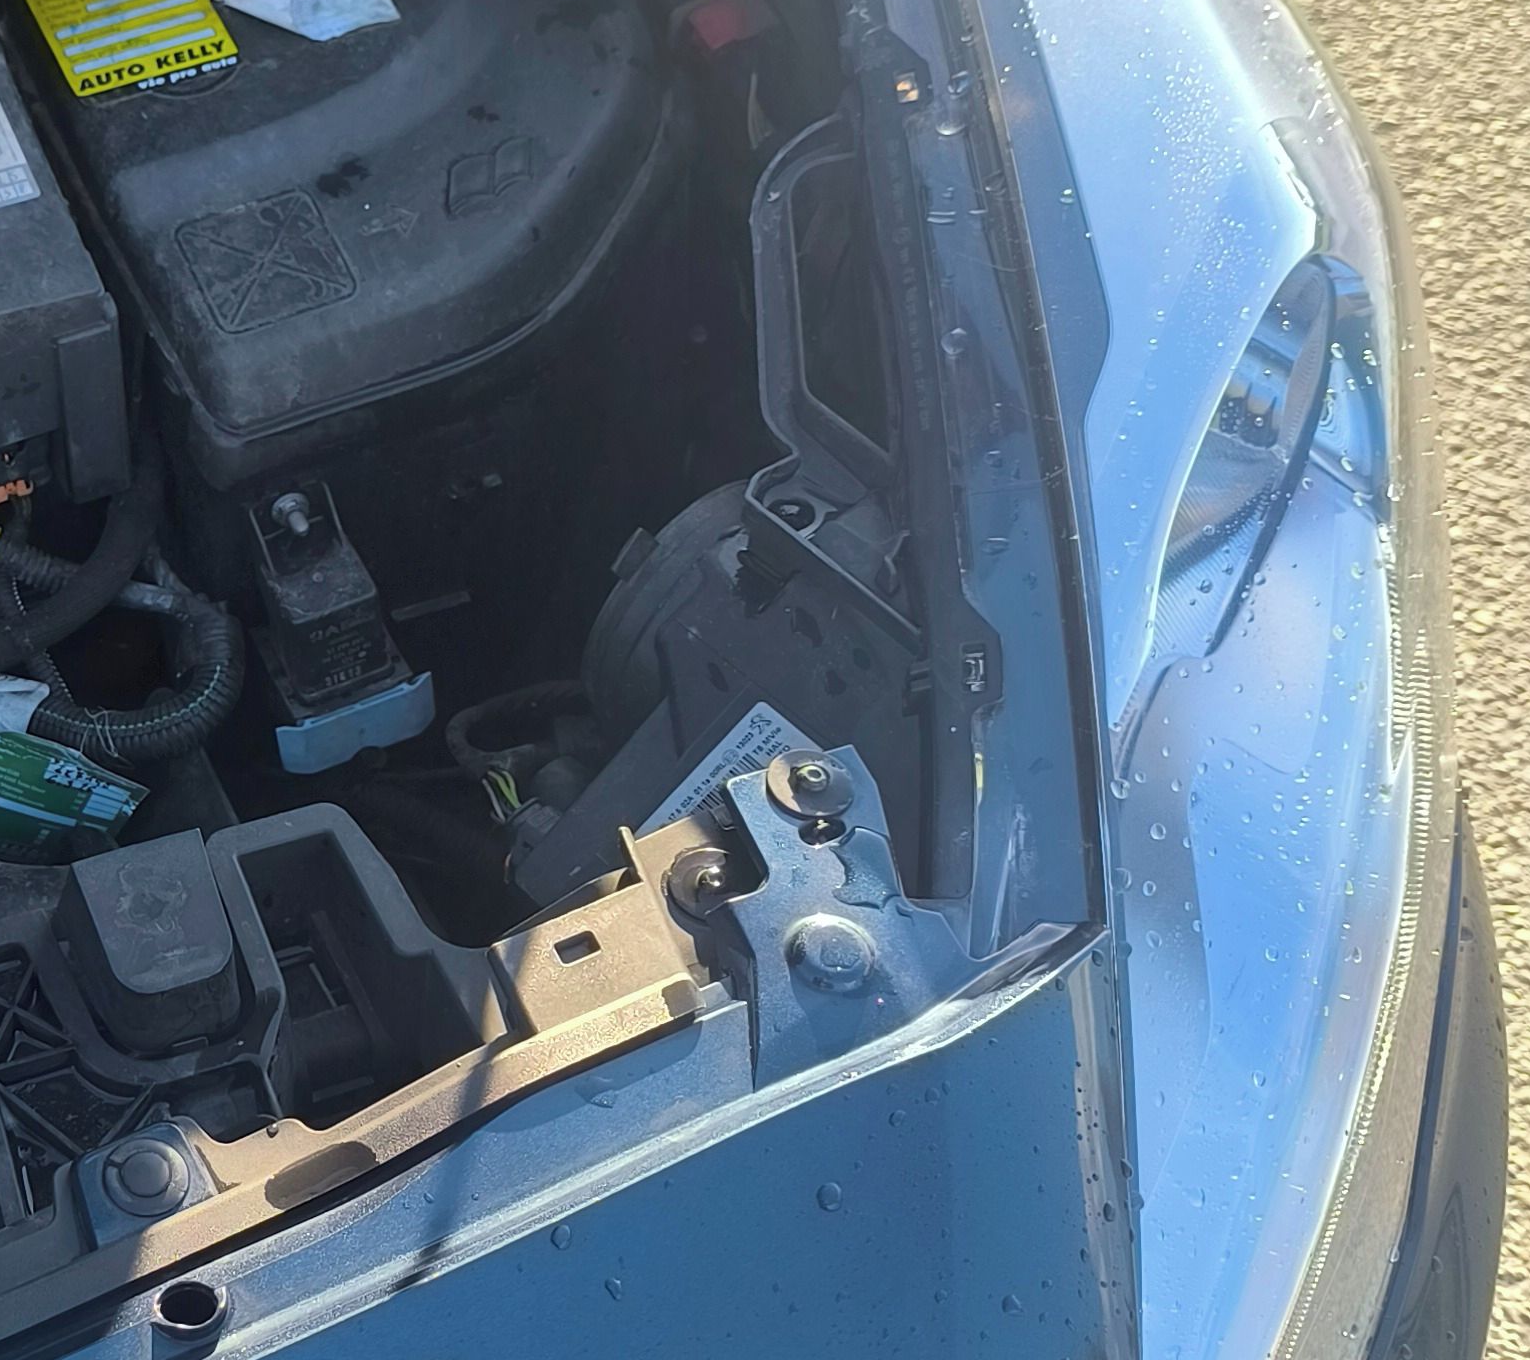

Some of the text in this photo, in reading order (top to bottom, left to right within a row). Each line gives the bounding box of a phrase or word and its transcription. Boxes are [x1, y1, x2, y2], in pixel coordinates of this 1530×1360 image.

[80, 64, 145, 91] AUTO
[155, 40, 226, 69] KELLY
[170, 68, 197, 84] pro
[765, 741, 783, 757] HAL
